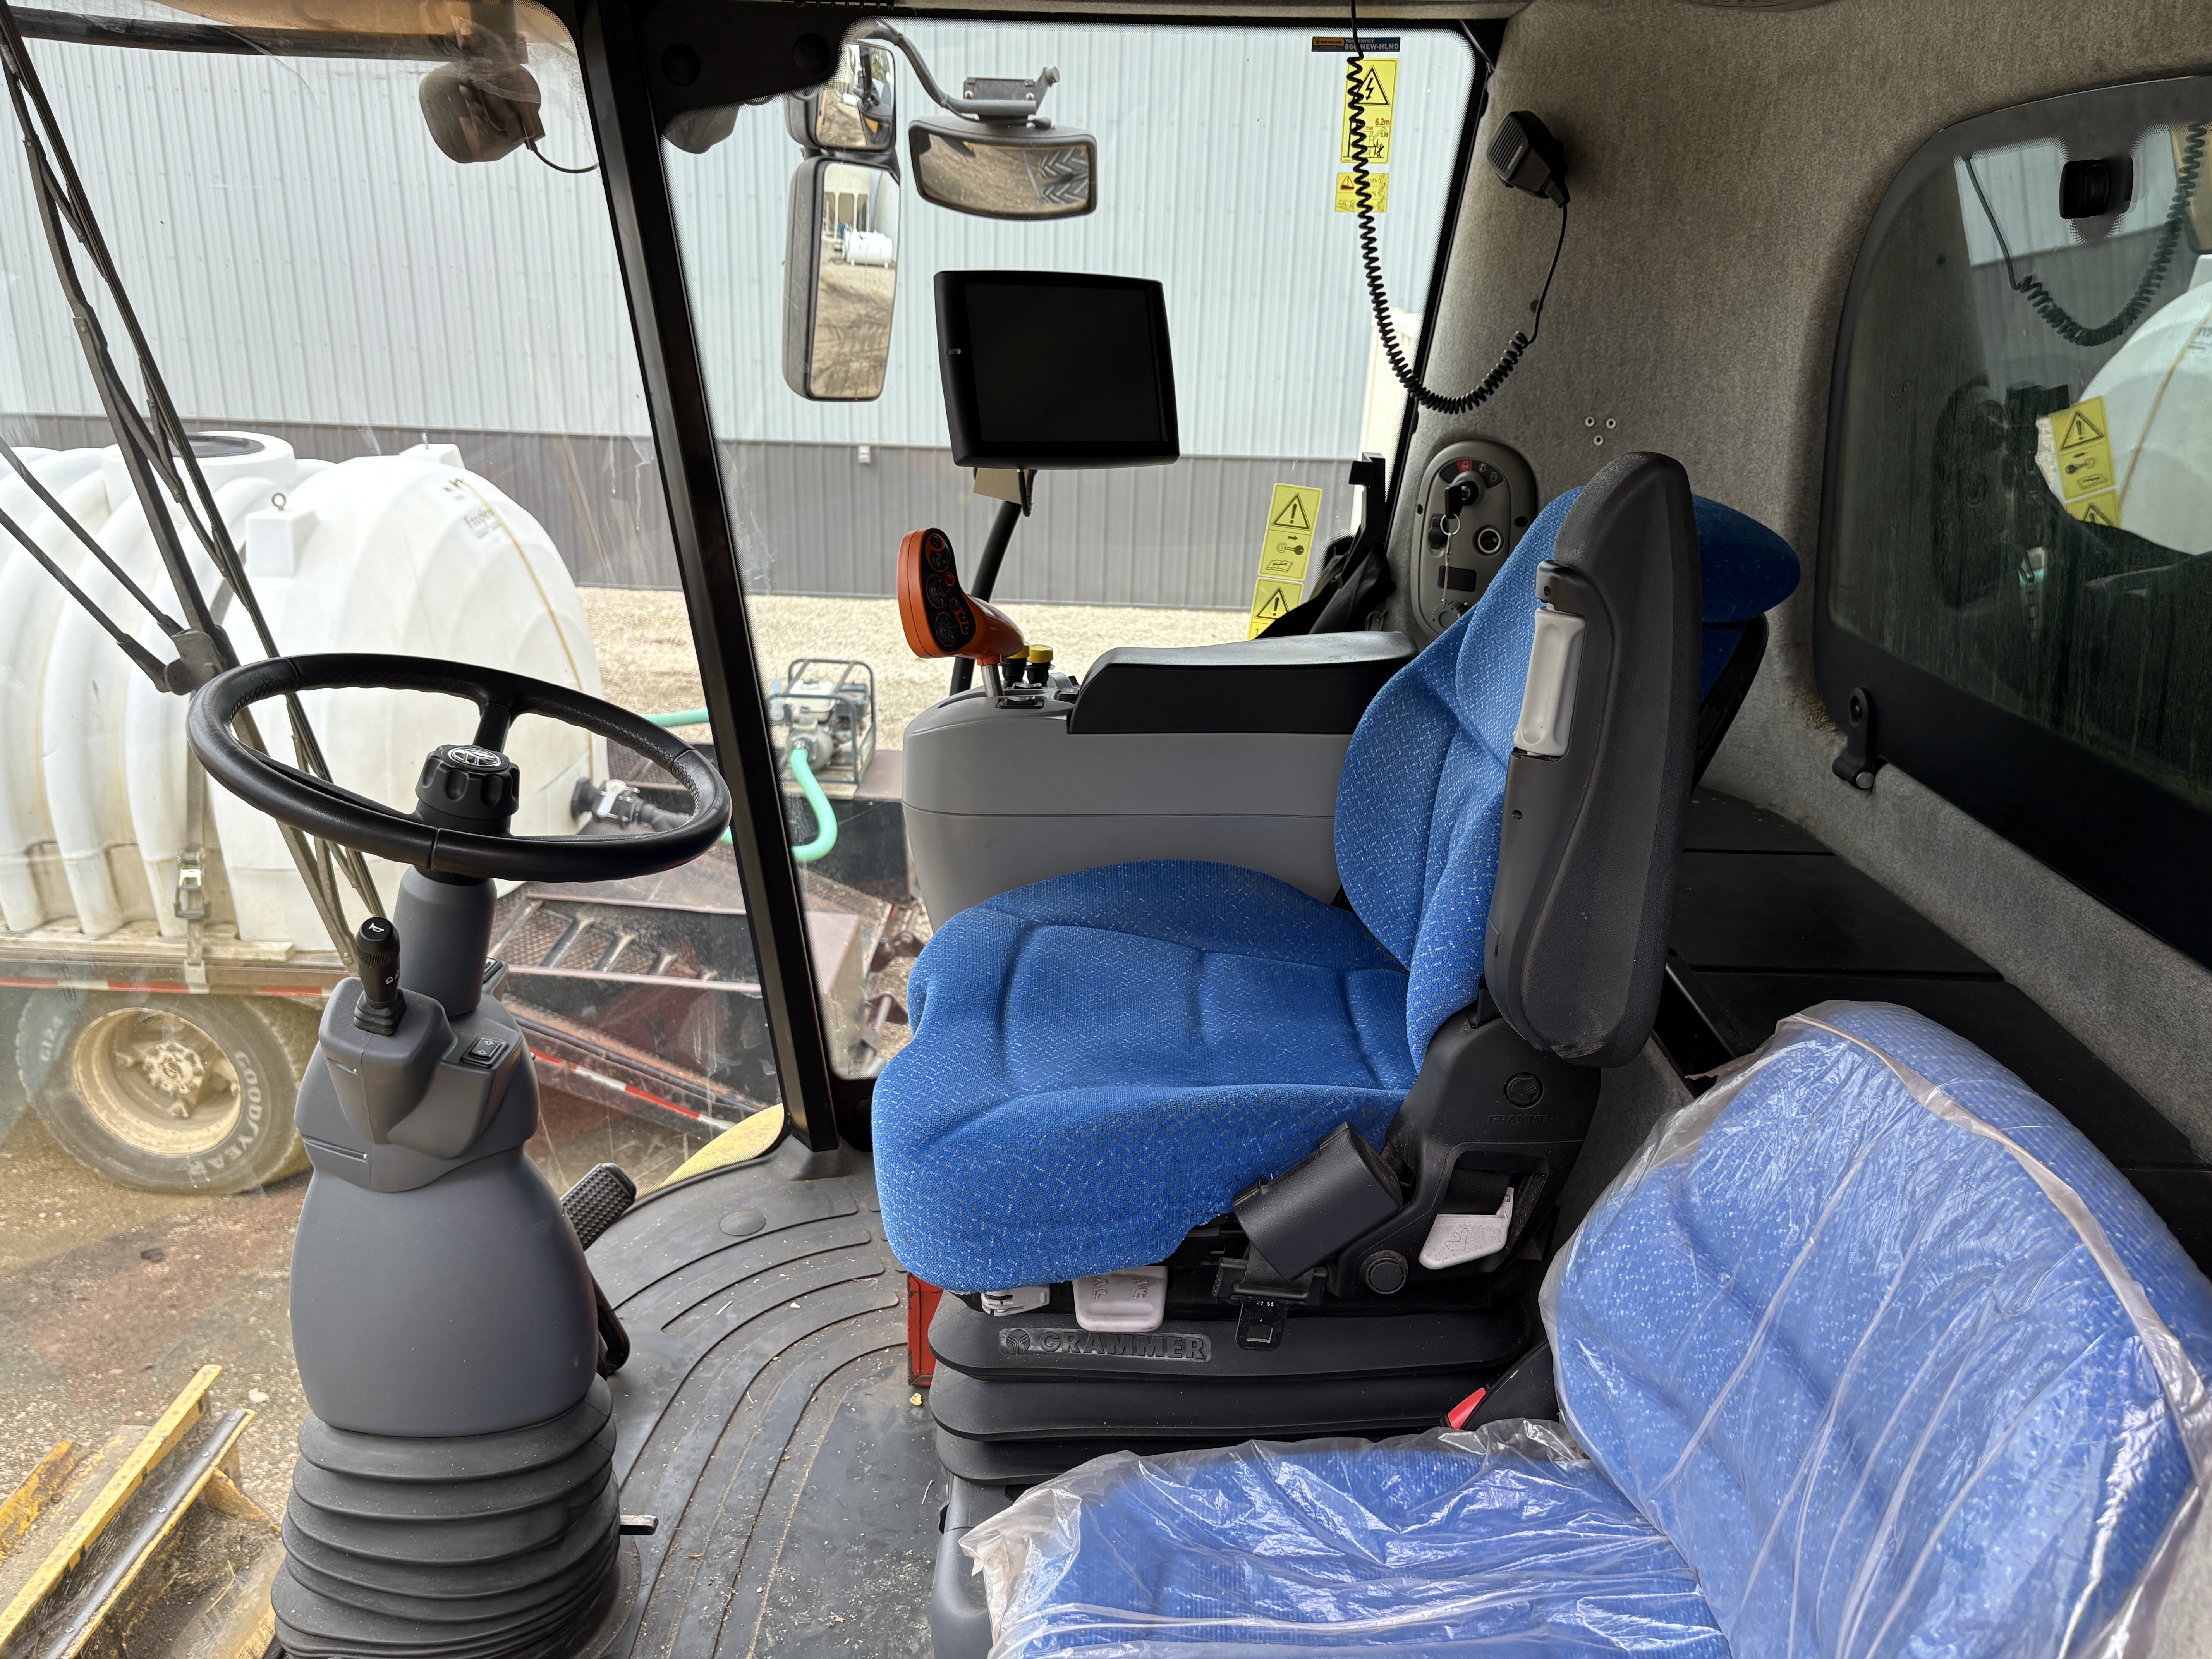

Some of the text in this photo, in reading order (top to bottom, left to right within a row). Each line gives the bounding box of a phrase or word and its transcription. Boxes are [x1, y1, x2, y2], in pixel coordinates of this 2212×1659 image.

[191, 1050, 263, 1176] GOODYEAR
[1487, 1114, 1554, 1124] GRAMMER
[1040, 1331, 1205, 1359] GRAMMER
